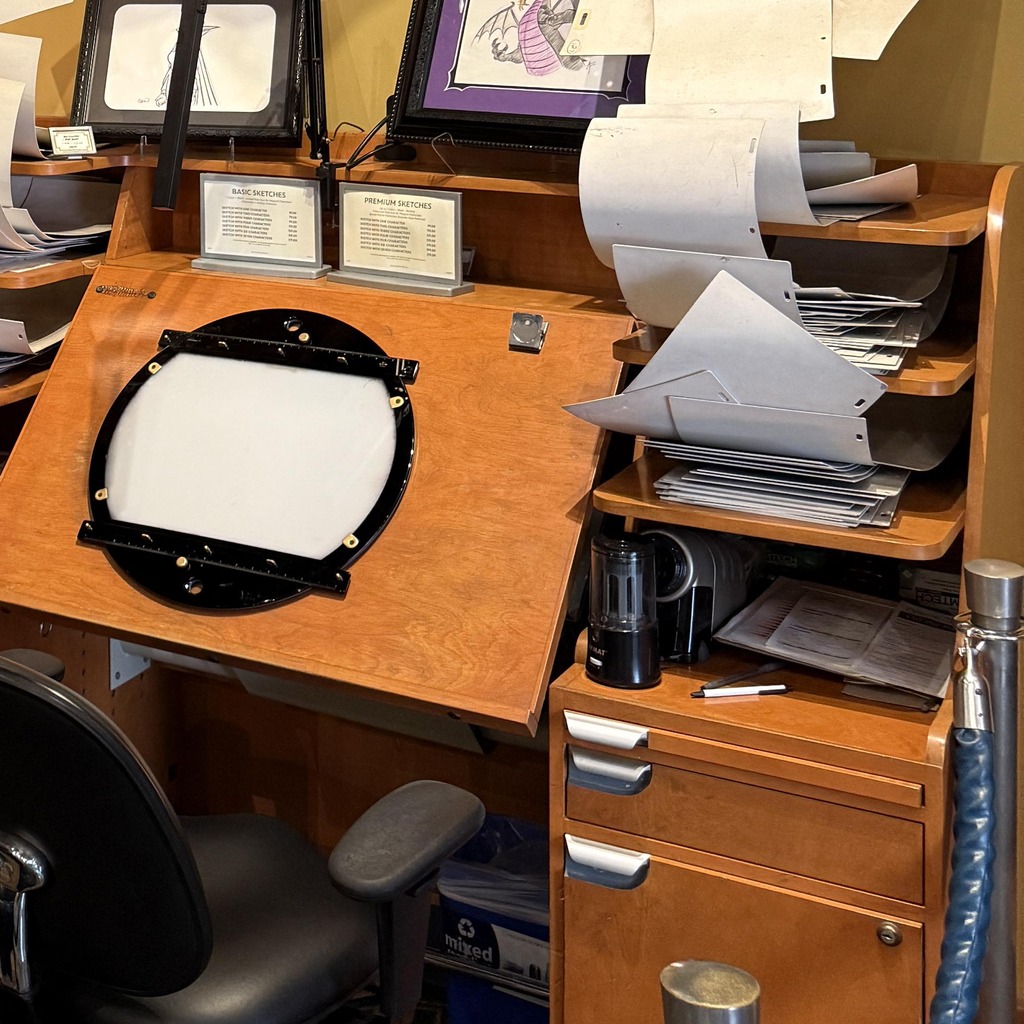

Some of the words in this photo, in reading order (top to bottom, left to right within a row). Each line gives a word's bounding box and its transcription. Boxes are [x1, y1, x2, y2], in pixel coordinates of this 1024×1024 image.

[253, 190, 286, 198] SKETCHES
[364, 197, 396, 206] PREMIUM
[398, 200, 432, 209] SKETCHES
[445, 933, 493, 963] mixed
